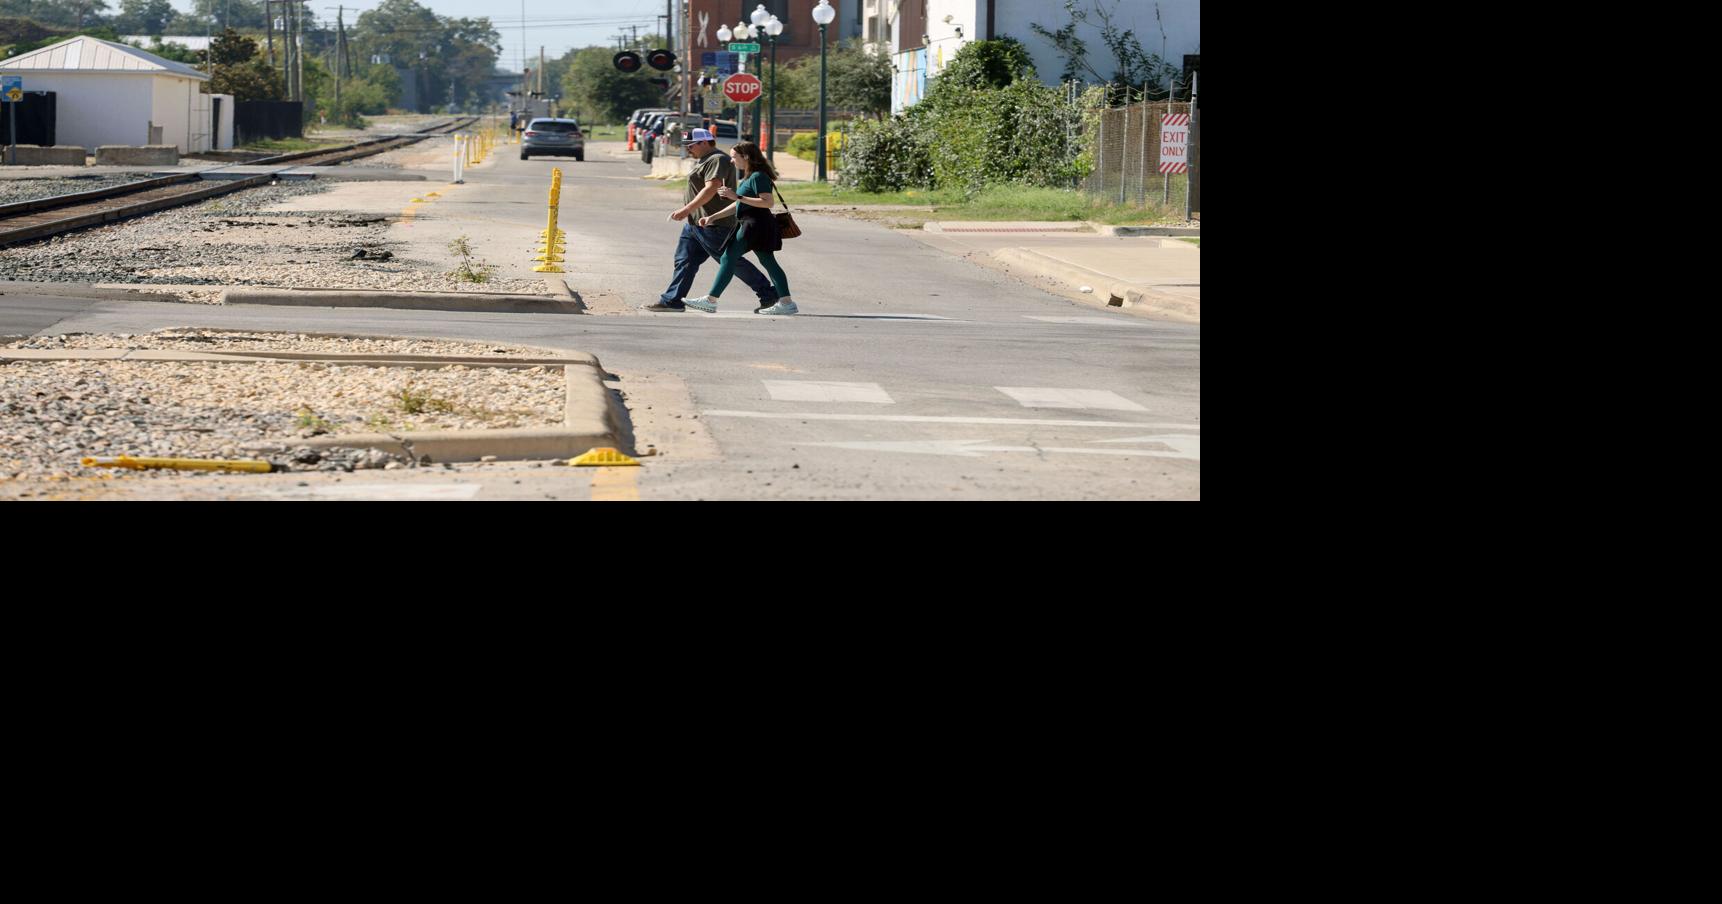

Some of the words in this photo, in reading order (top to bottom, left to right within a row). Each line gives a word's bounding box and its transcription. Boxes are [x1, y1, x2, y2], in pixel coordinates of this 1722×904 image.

[726, 82, 759, 94] STOP
[1163, 131, 1185, 143] EXIT
[1162, 146, 1185, 157] ONLY
